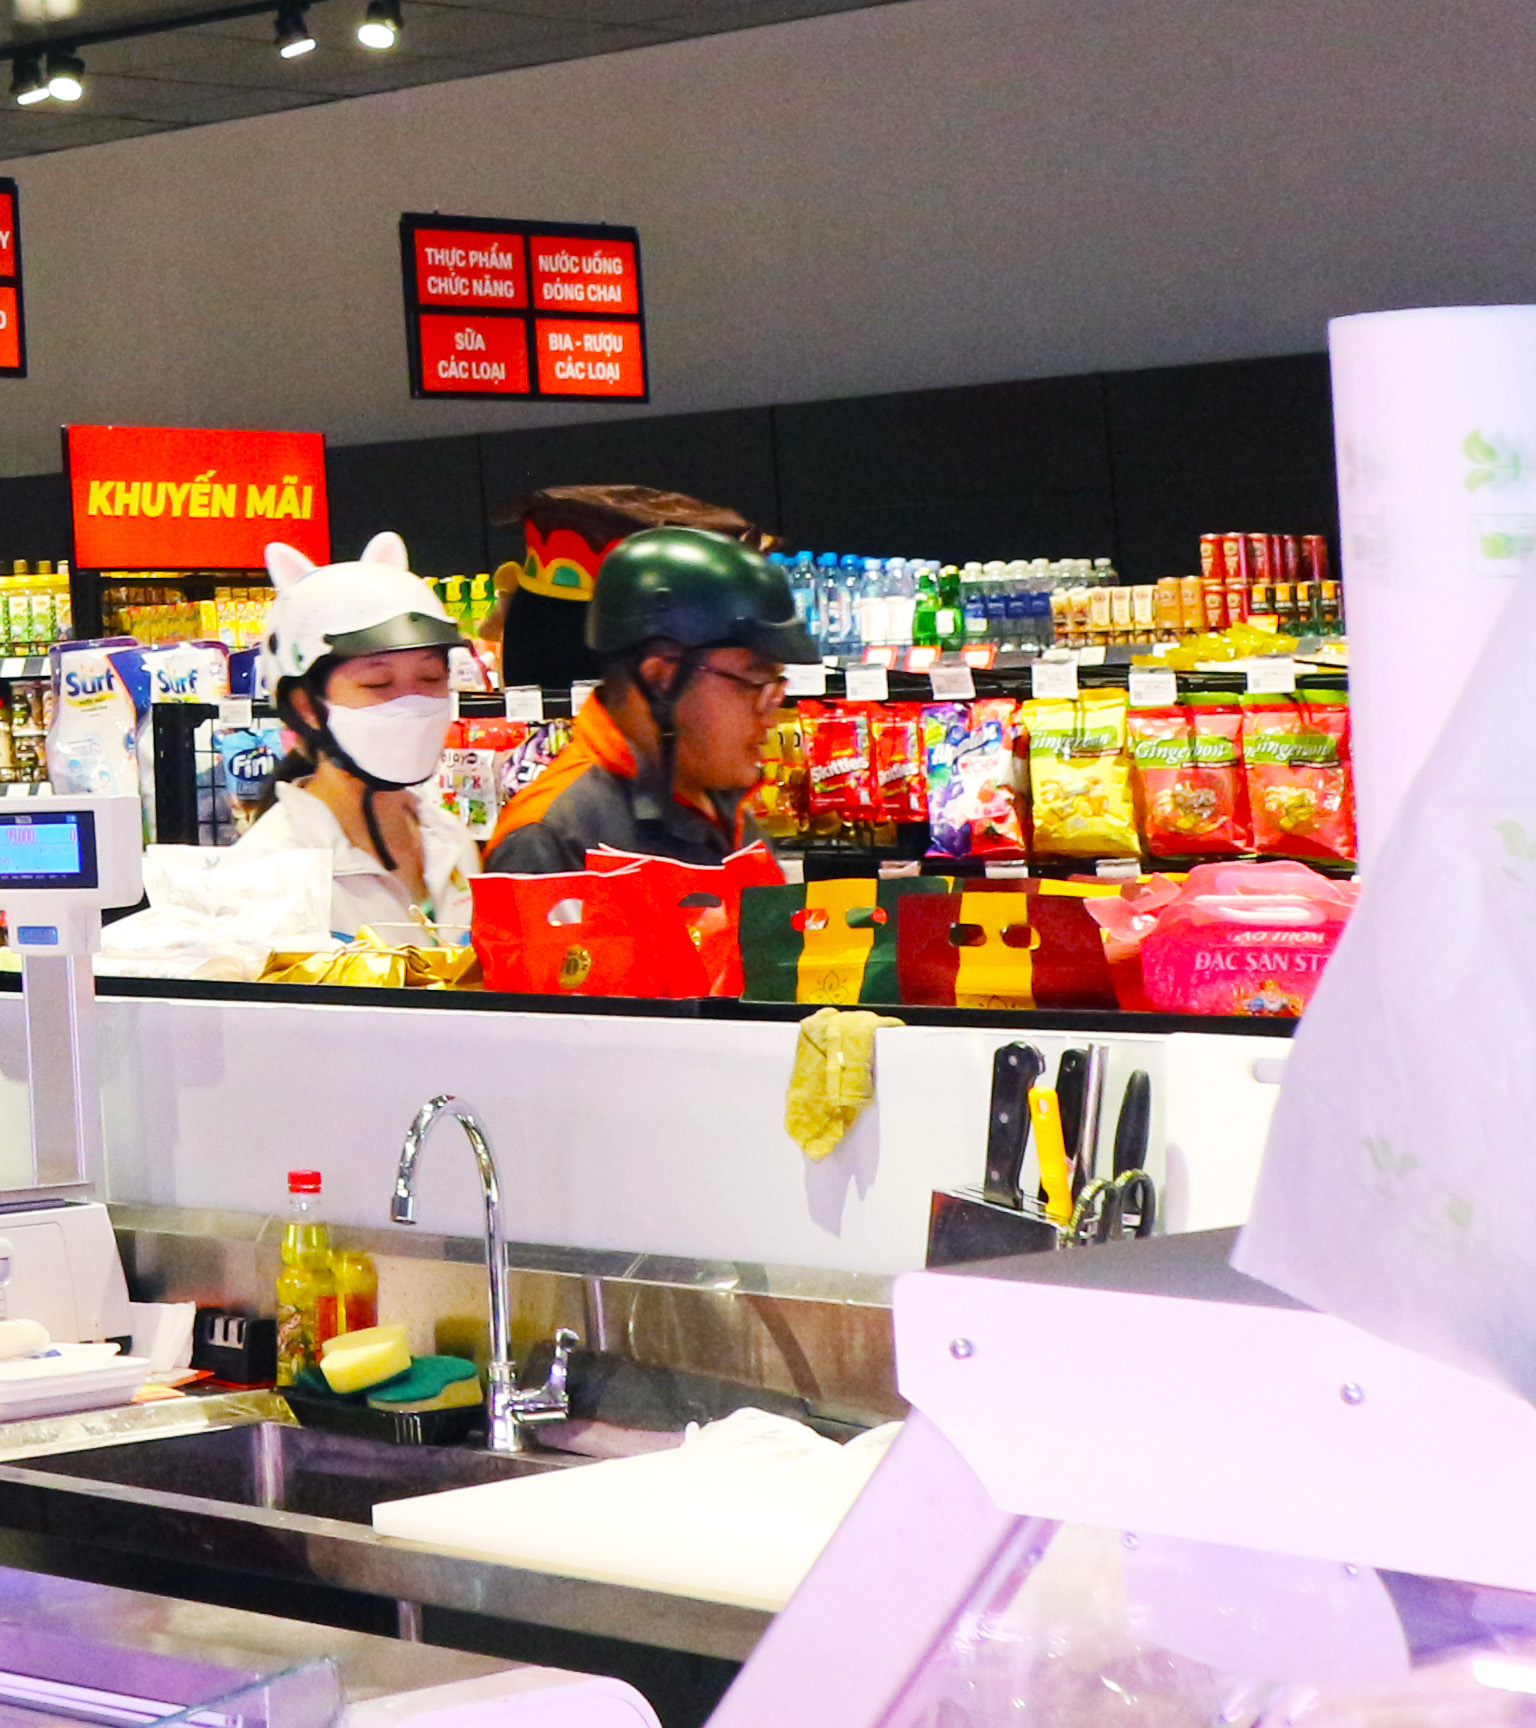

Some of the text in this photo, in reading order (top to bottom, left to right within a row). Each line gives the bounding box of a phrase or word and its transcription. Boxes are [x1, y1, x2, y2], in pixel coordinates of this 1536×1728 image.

[425, 243, 513, 271] THỰC PHẨM
[472, 275, 514, 298] NĂNG
[543, 278, 622, 303] ĐÓNG CHAI
[548, 333, 574, 352] BIA
[584, 333, 623, 357] RƯỢU
[438, 356, 506, 385] CÁC LOẠI
[555, 357, 621, 385] CÁC LOẠI
[88, 470, 313, 521] KHUYẾN MÃI
[66, 668, 116, 697] Surf
[157, 668, 198, 694] Surf
[232, 749, 276, 779] Fini
[811, 756, 871, 783] Skittles
